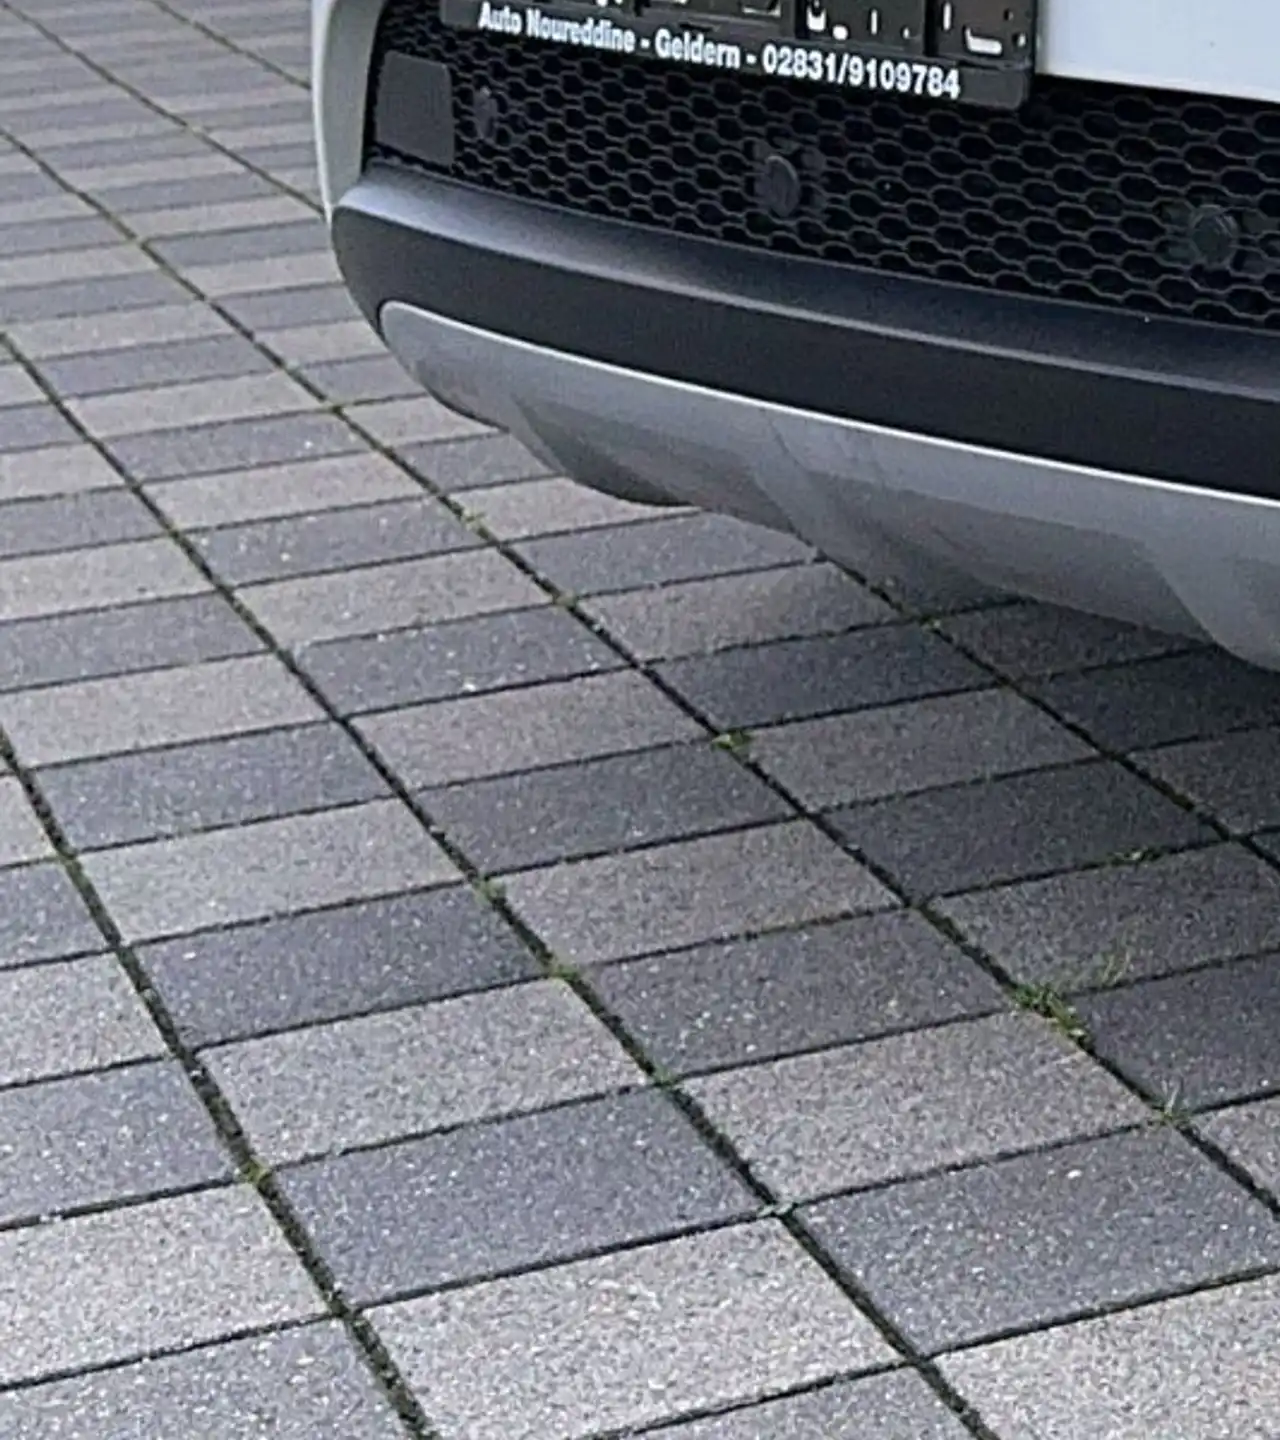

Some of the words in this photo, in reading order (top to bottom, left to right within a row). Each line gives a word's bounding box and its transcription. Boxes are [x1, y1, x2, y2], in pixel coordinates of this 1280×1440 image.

[478, 1, 522, 35] Auto
[526, 9, 636, 53] Noureddine
[655, 28, 741, 69] Geldern
[761, 43, 961, 100] 02831/9109784
